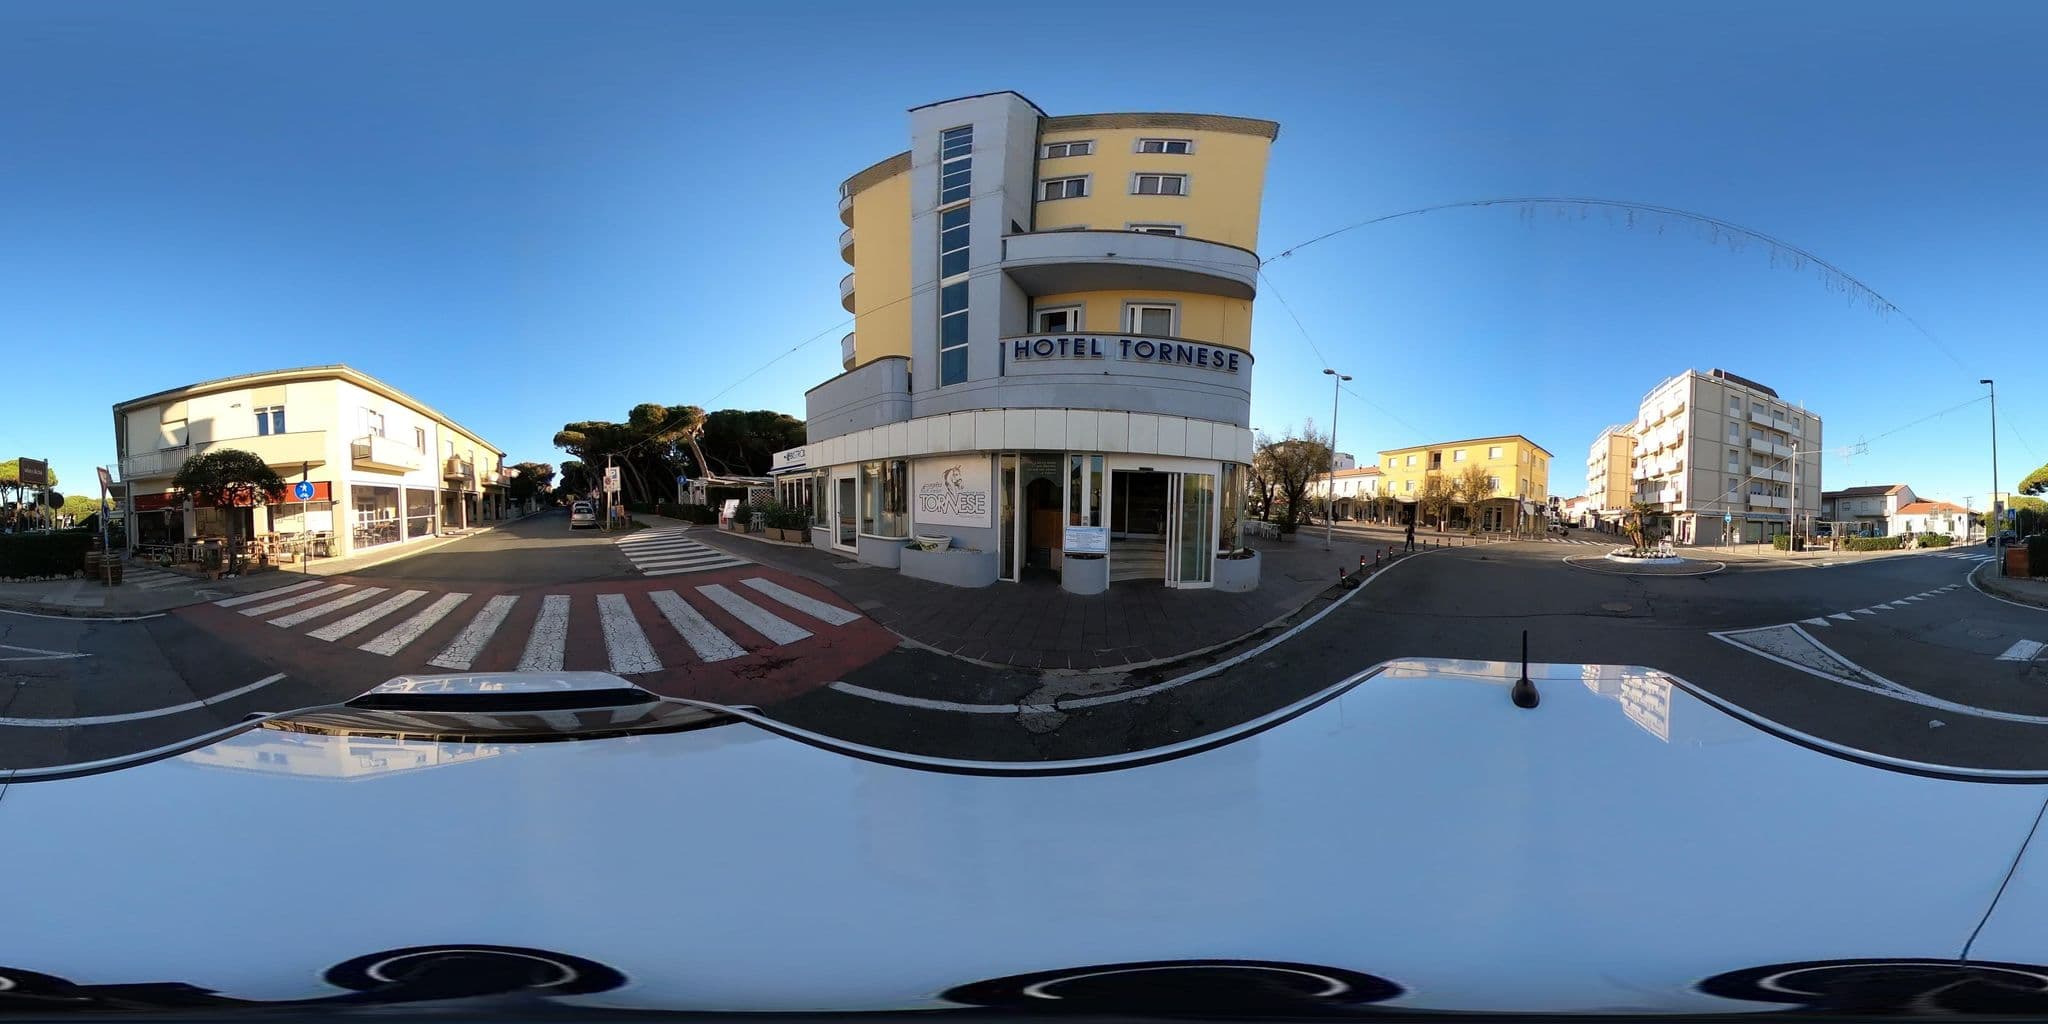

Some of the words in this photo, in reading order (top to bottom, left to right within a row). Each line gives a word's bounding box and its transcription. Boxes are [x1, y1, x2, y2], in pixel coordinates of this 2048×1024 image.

[1014, 338, 1102, 358] HOTEL
[1119, 339, 1239, 371] TORNESE
[919, 492, 985, 515] TORNESE
